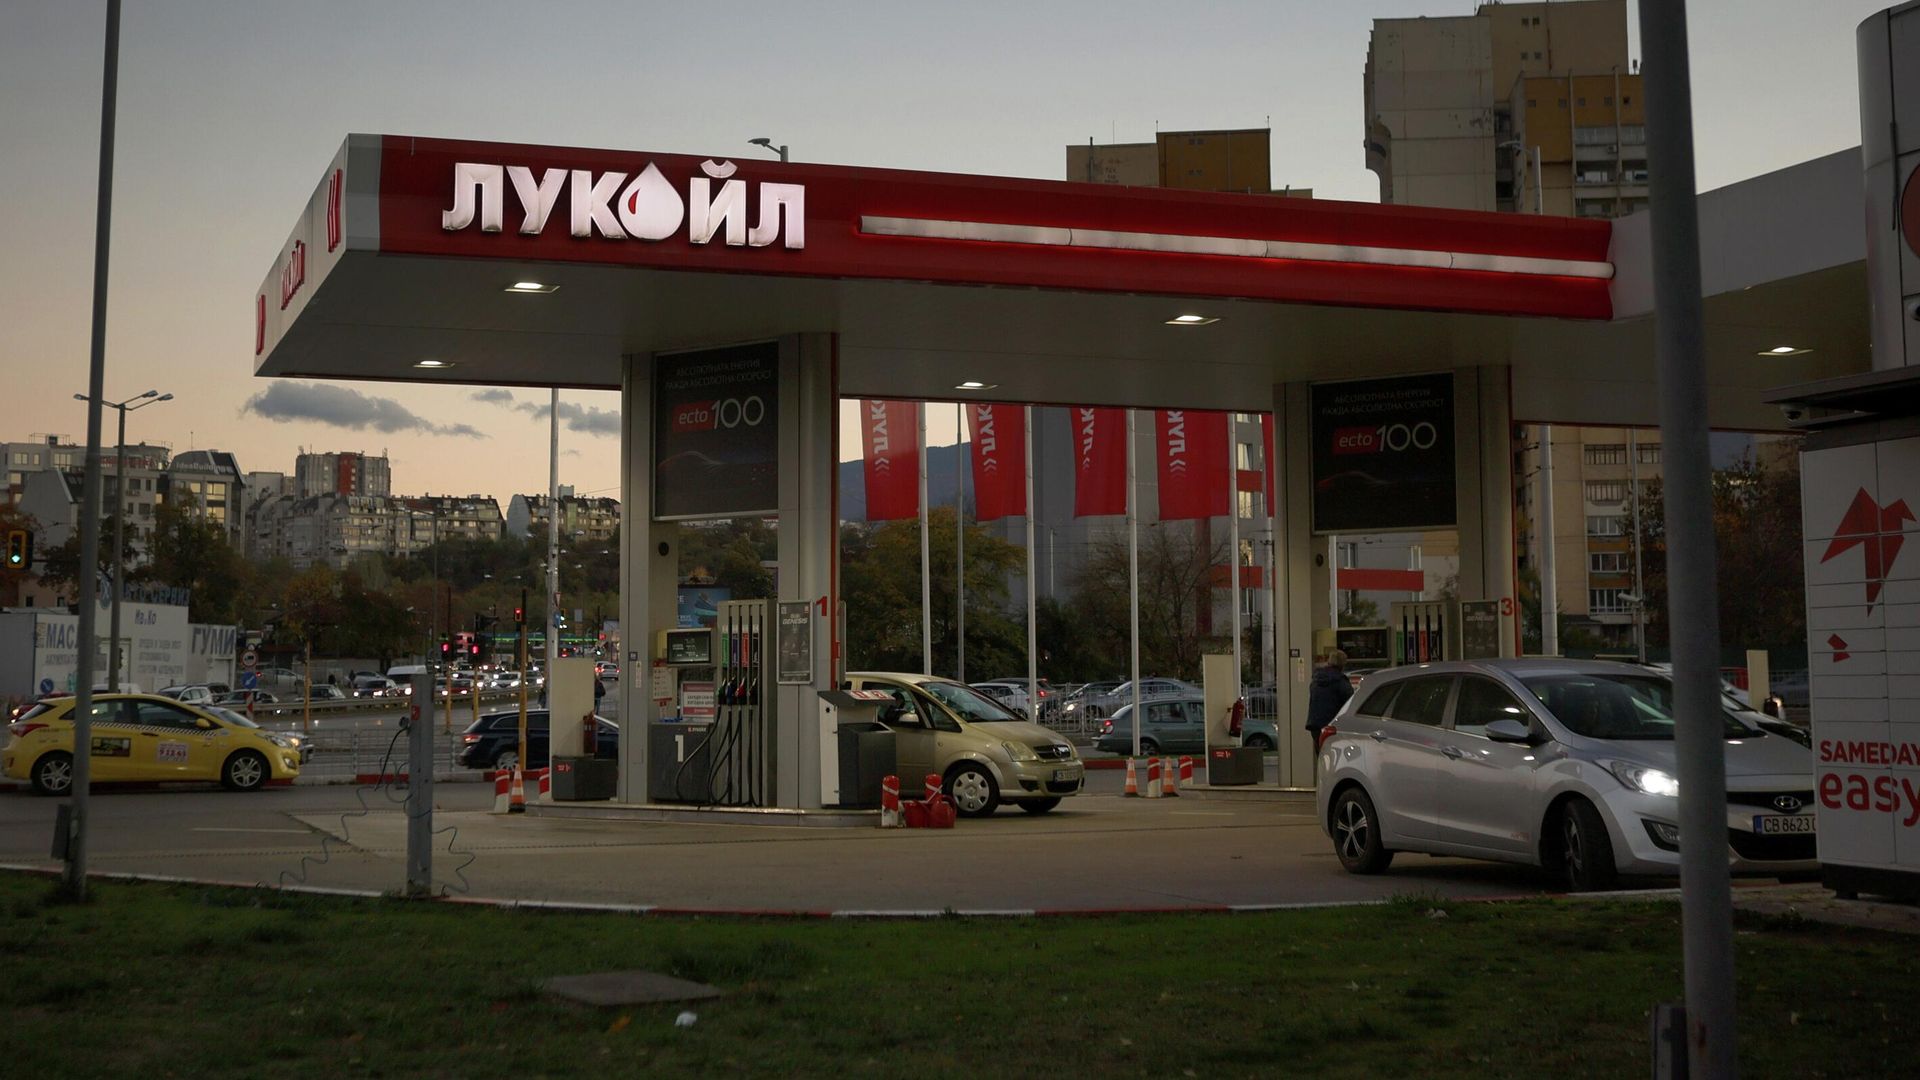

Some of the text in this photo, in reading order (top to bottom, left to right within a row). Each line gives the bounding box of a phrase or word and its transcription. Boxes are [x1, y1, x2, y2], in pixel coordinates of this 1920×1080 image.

[442, 159, 805, 249] ЛУКОЙЛ
[816, 596, 828, 616] 1
[1501, 598, 1514, 616] 3
[192, 627, 235, 655] ГУМИ
[675, 734, 684, 763] 1
[1820, 740, 1920, 766] SAMEDAY
[1782, 817, 1810, 832] 8623
